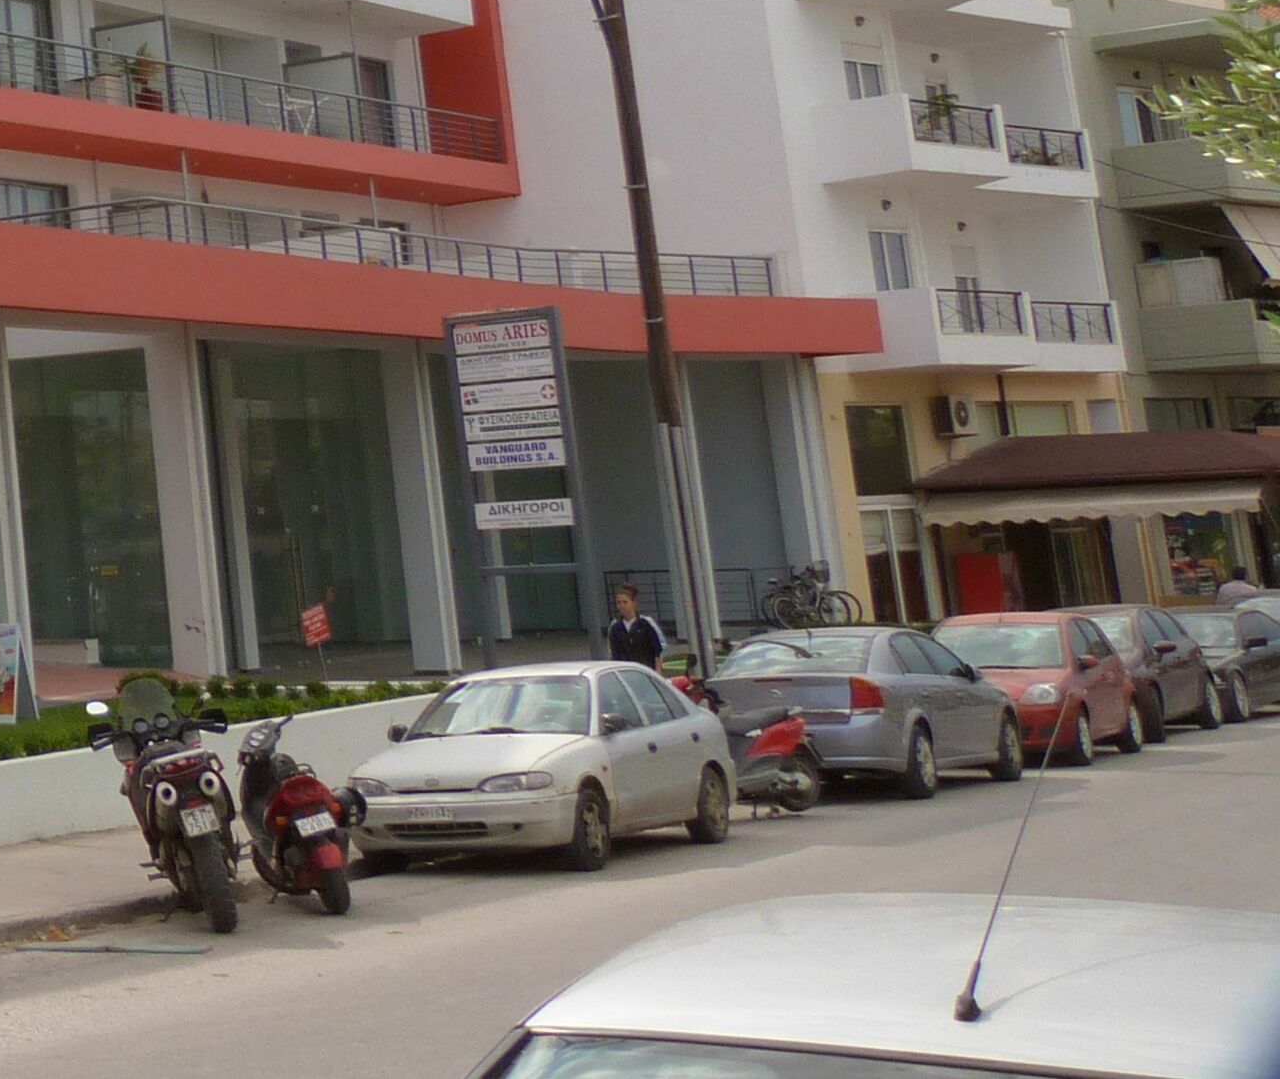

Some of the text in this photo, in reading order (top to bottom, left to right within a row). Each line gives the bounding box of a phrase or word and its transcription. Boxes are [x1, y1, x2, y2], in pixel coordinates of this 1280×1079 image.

[455, 329, 498, 345] DOMUS
[501, 322, 548, 341] ARIES
[477, 410, 559, 425] ΦΥΣΙΚΟΘΕΡΑΠΕΙΑ
[485, 442, 547, 454] VANGUARD
[475, 452, 559, 465] BUILDINGS S.A.
[488, 501, 565, 515] ΔΙΚΗΓΟΡΟΙ
